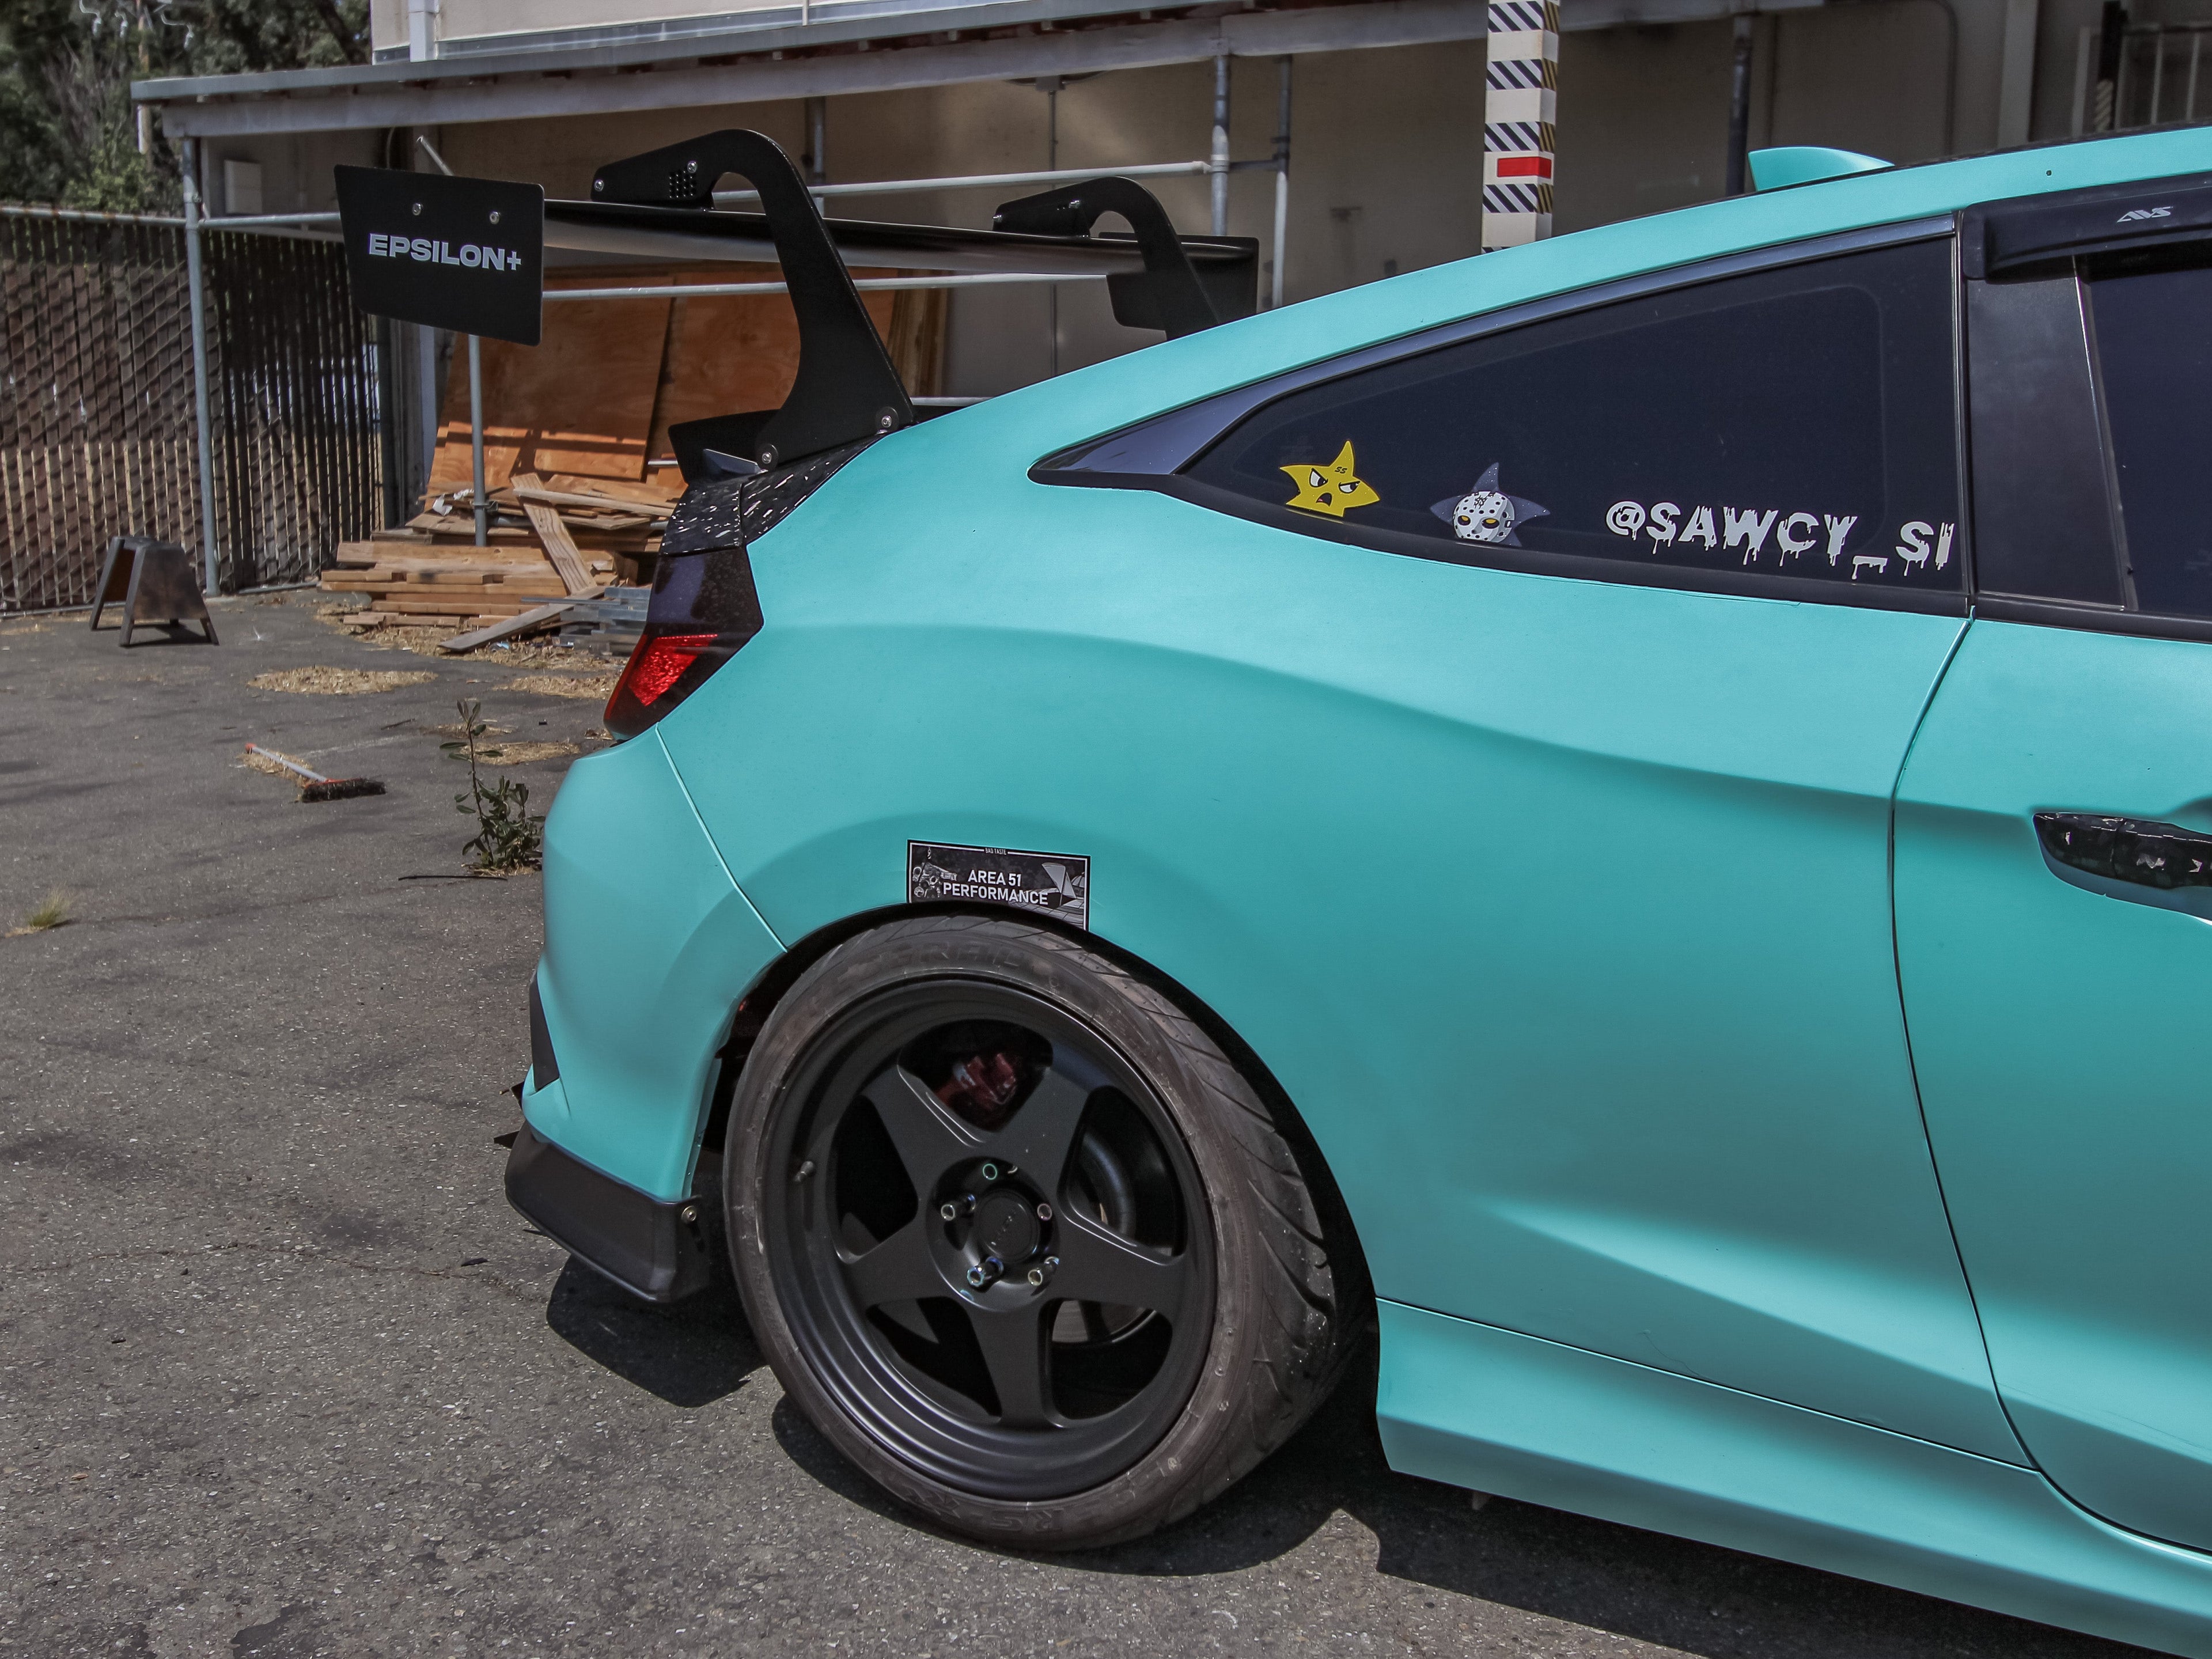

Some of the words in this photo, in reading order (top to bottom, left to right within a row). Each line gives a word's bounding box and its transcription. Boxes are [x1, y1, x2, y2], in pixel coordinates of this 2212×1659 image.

[2116, 206, 2173, 223] AVS
[368, 233, 522, 271] EPSILON+
[967, 869, 1006, 886] AREA
[1008, 873, 1022, 887] 51
[942, 881, 1048, 906] PERFORMANCE
